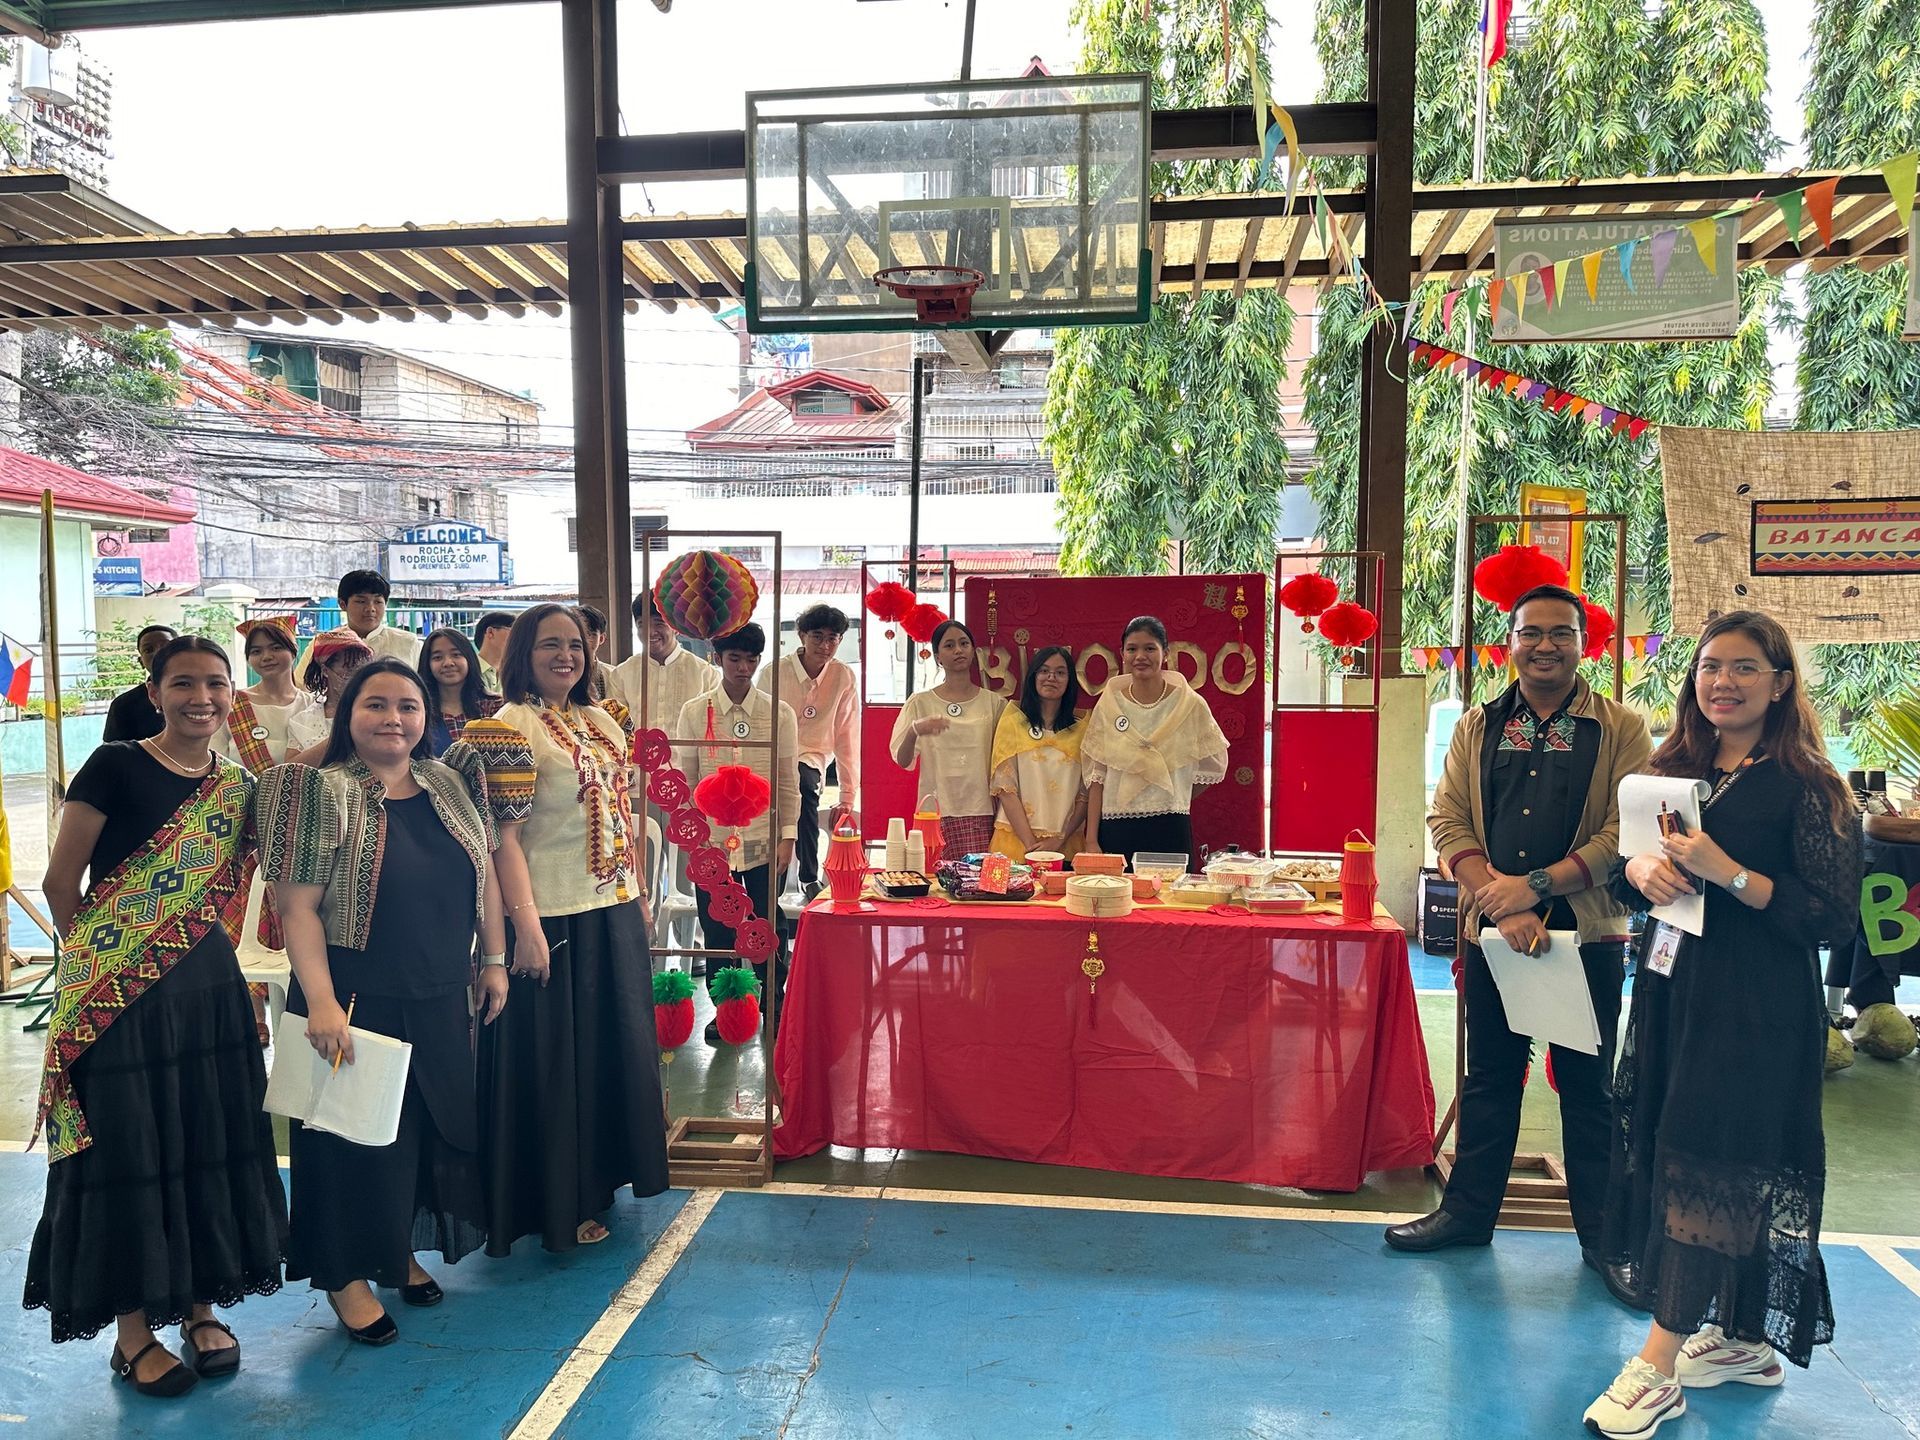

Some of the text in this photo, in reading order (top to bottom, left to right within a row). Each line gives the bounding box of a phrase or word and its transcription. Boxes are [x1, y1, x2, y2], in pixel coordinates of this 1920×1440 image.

[404, 528, 480, 543] WELCOME
[418, 546, 455, 555] ROCHA
[400, 554, 489, 564] RODRIGUEZ COMP.
[103, 565, 138, 575] KITCHEN
[976, 628, 1257, 698] BiODO
[1118, 717, 1127, 728] 8
[738, 723, 746, 734] 8
